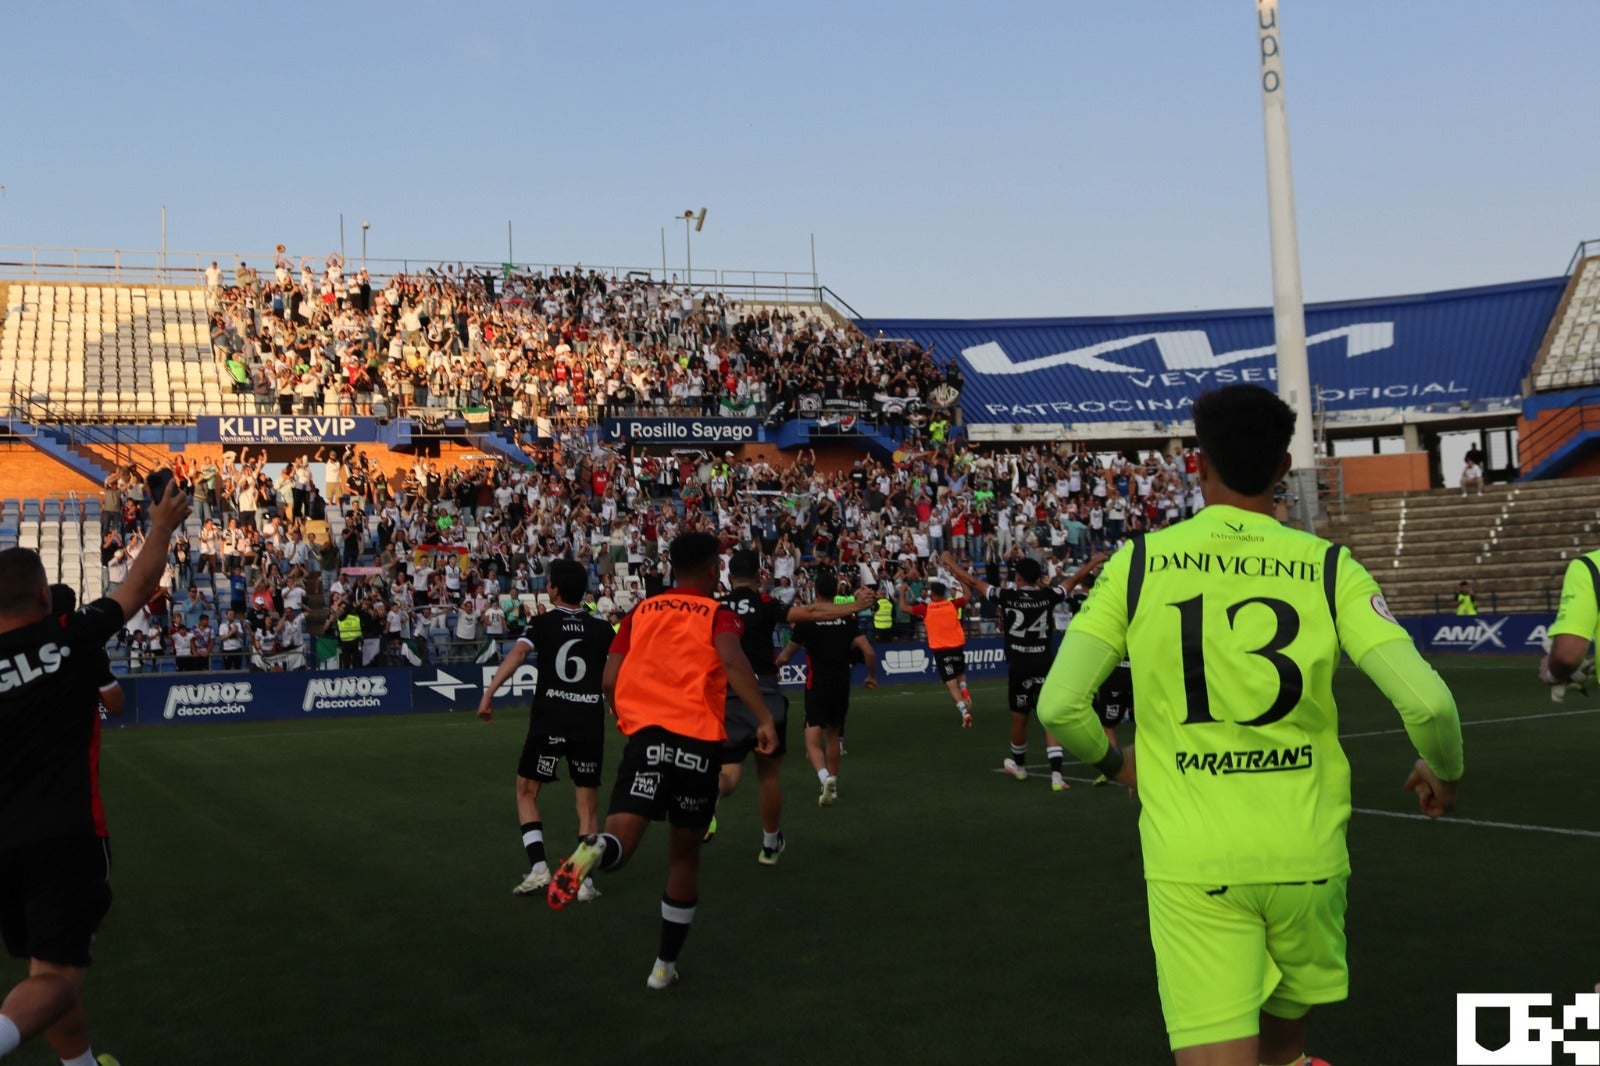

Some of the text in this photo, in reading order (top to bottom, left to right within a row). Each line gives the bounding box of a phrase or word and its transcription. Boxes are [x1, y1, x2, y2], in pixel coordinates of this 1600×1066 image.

[1259, 0, 1279, 93] upo
[1318, 381, 1469, 401] OFICIAL
[219, 417, 356, 437] KLIPERVIP
[630, 422, 688, 438] Rosillo
[692, 423, 753, 441] Sayago
[220, 435, 254, 443] Ventanas
[281, 434, 322, 443] Technology
[1149, 552, 1320, 582] DANI VICENTE
[561, 624, 585, 632] MIKI
[1005, 607, 1049, 639] 24
[555, 638, 587, 683] 6
[1165, 593, 1304, 727] 13
[177, 704, 246, 716] decoración
[315, 697, 381, 708] decoración
